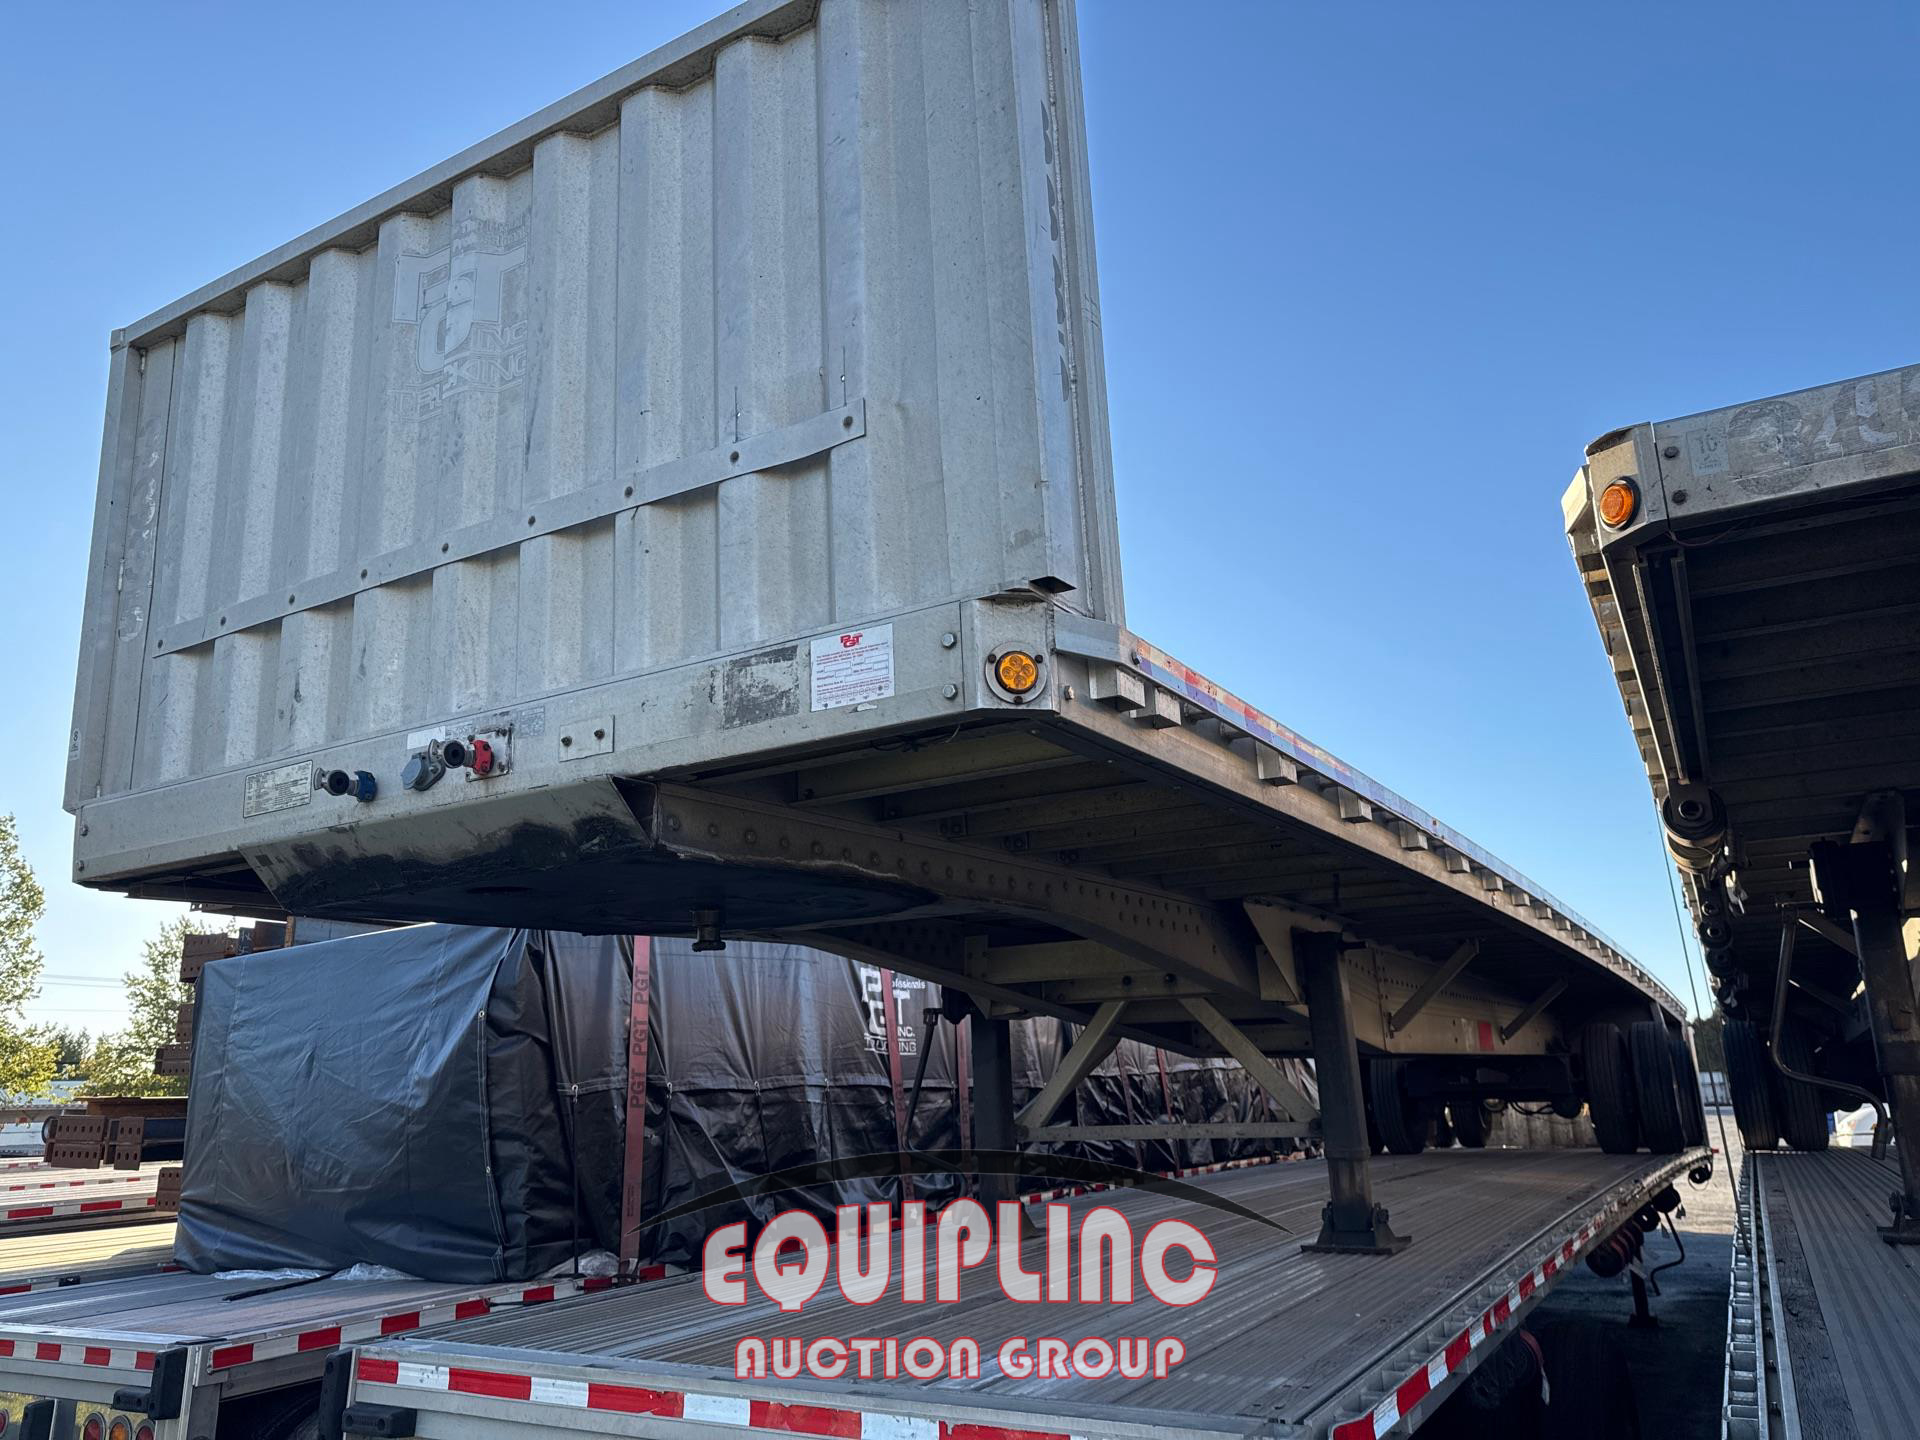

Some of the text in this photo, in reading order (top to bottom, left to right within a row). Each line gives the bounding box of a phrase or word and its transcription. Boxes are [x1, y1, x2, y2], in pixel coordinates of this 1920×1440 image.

[629, 965, 649, 1109] PGT PGT PGT
[866, 1038, 917, 1053] TRUCING
